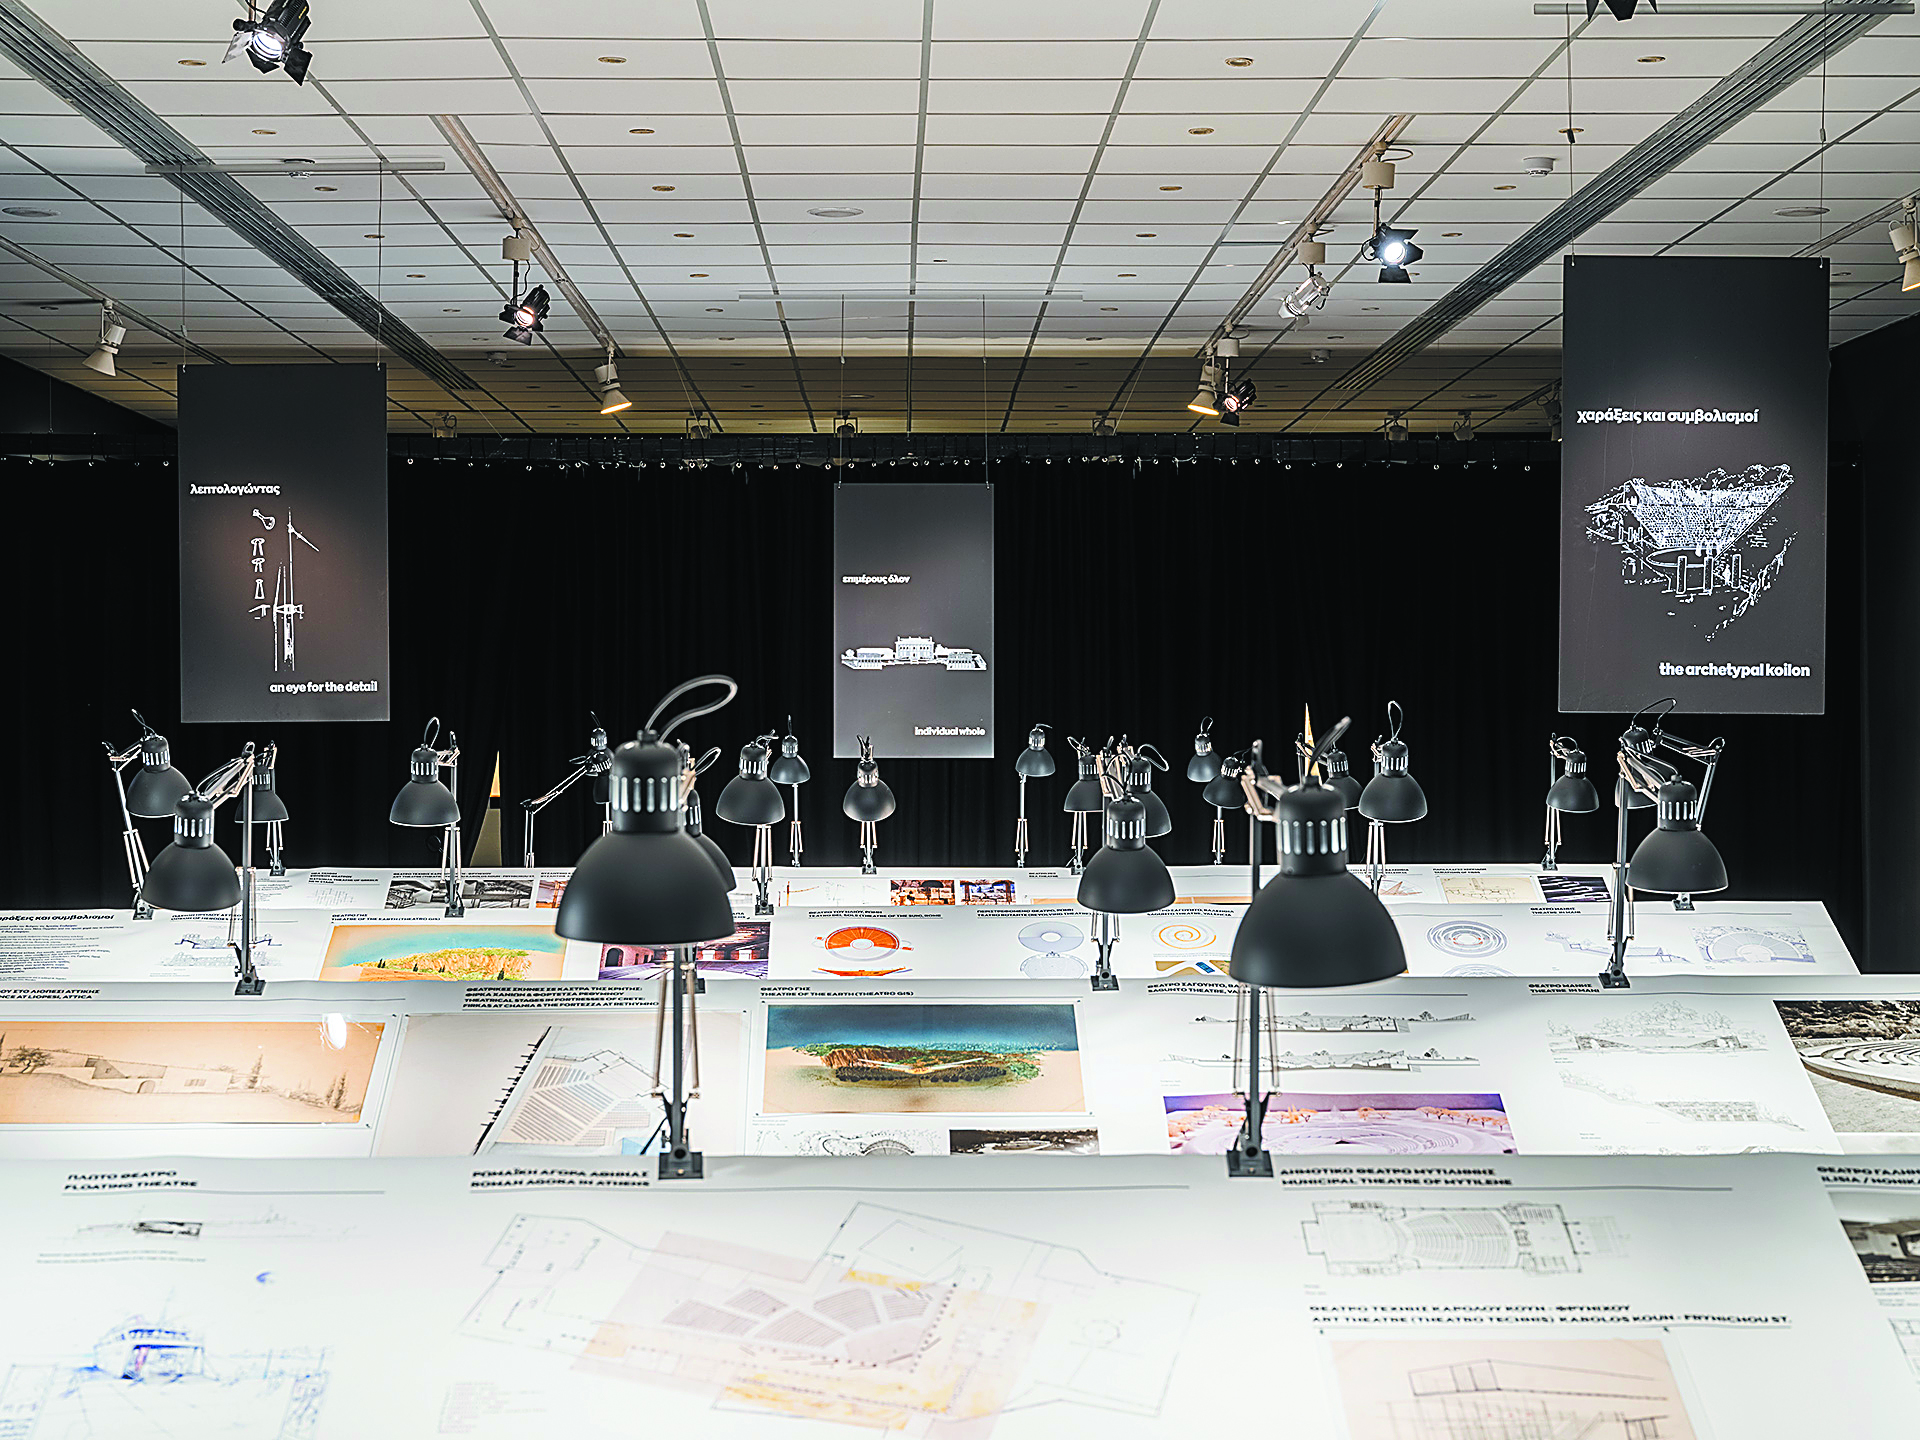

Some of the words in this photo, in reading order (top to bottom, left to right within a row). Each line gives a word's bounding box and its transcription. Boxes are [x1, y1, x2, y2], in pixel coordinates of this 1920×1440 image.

[1577, 407, 1642, 423] χαράξεις
[1643, 411, 1666, 422] και
[1667, 408, 1759, 424] συμβολισμοί
[190, 483, 281, 495] λεπτολογώντας
[842, 574, 888, 584] επιμέρους
[888, 574, 911, 583] όλον
[1659, 662, 1684, 676] the
[1685, 662, 1764, 678] archetypal
[1765, 662, 1811, 676] koilon
[269, 683, 286, 693] an
[286, 684, 307, 694] eye
[307, 682, 325, 693] for
[325, 682, 345, 692] the
[345, 680, 378, 692] detail
[959, 726, 986, 736] whole
[120, 1170, 177, 1179] ΘΕΑΤΡΟ
[1280, 1167, 1354, 1175] ΔΗΜΟΤΙΚΟ
[1356, 1167, 1412, 1175] ΘΕΑΤΡΟ
[1817, 1166, 1872, 1175] ΘΕΑΤΡΟ
[471, 1179, 523, 1187] ROMAN
[1282, 1177, 1358, 1185] MUNICIPAL
[64, 1182, 133, 1190] FLOATING
[1559, 1315, 1630, 1323] KAROLOS
[1632, 1314, 1675, 1322] KOUN
